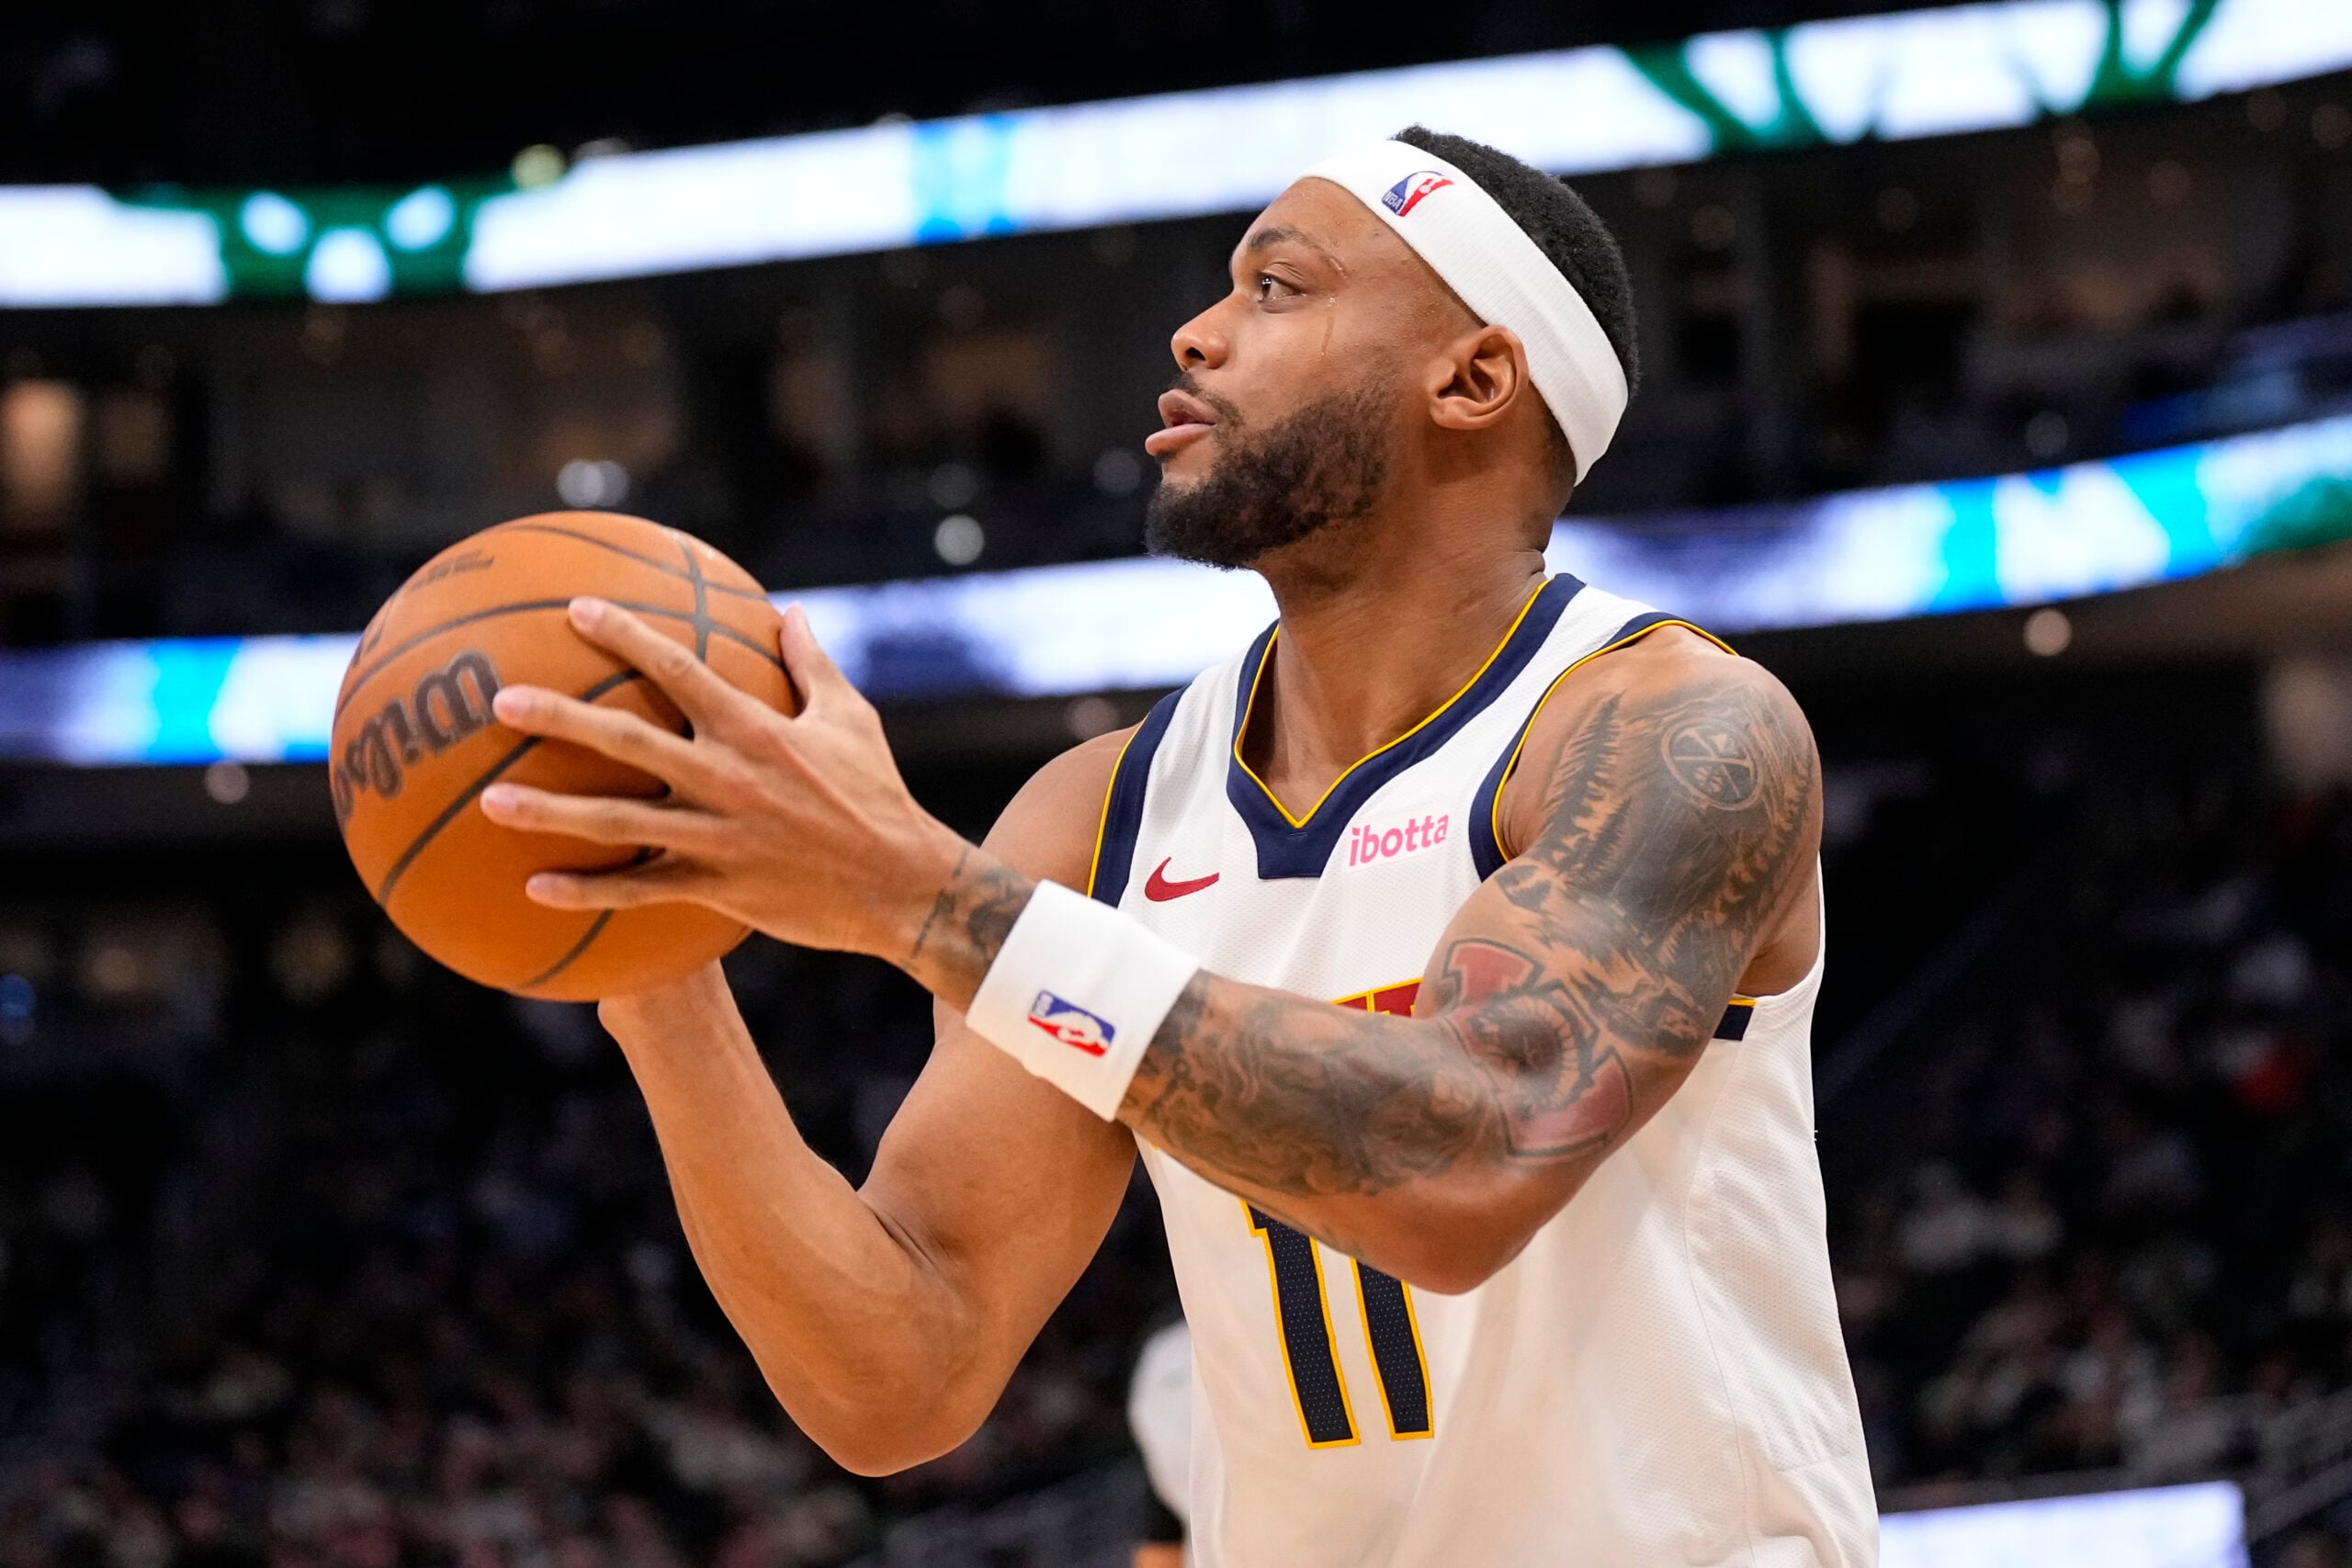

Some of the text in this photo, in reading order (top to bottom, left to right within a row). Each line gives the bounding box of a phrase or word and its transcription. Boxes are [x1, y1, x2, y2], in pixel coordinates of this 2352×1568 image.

[1383, 190, 1404, 210] NBA
[334, 649, 503, 827] Wilso
[1349, 814, 1449, 867] ibotta
